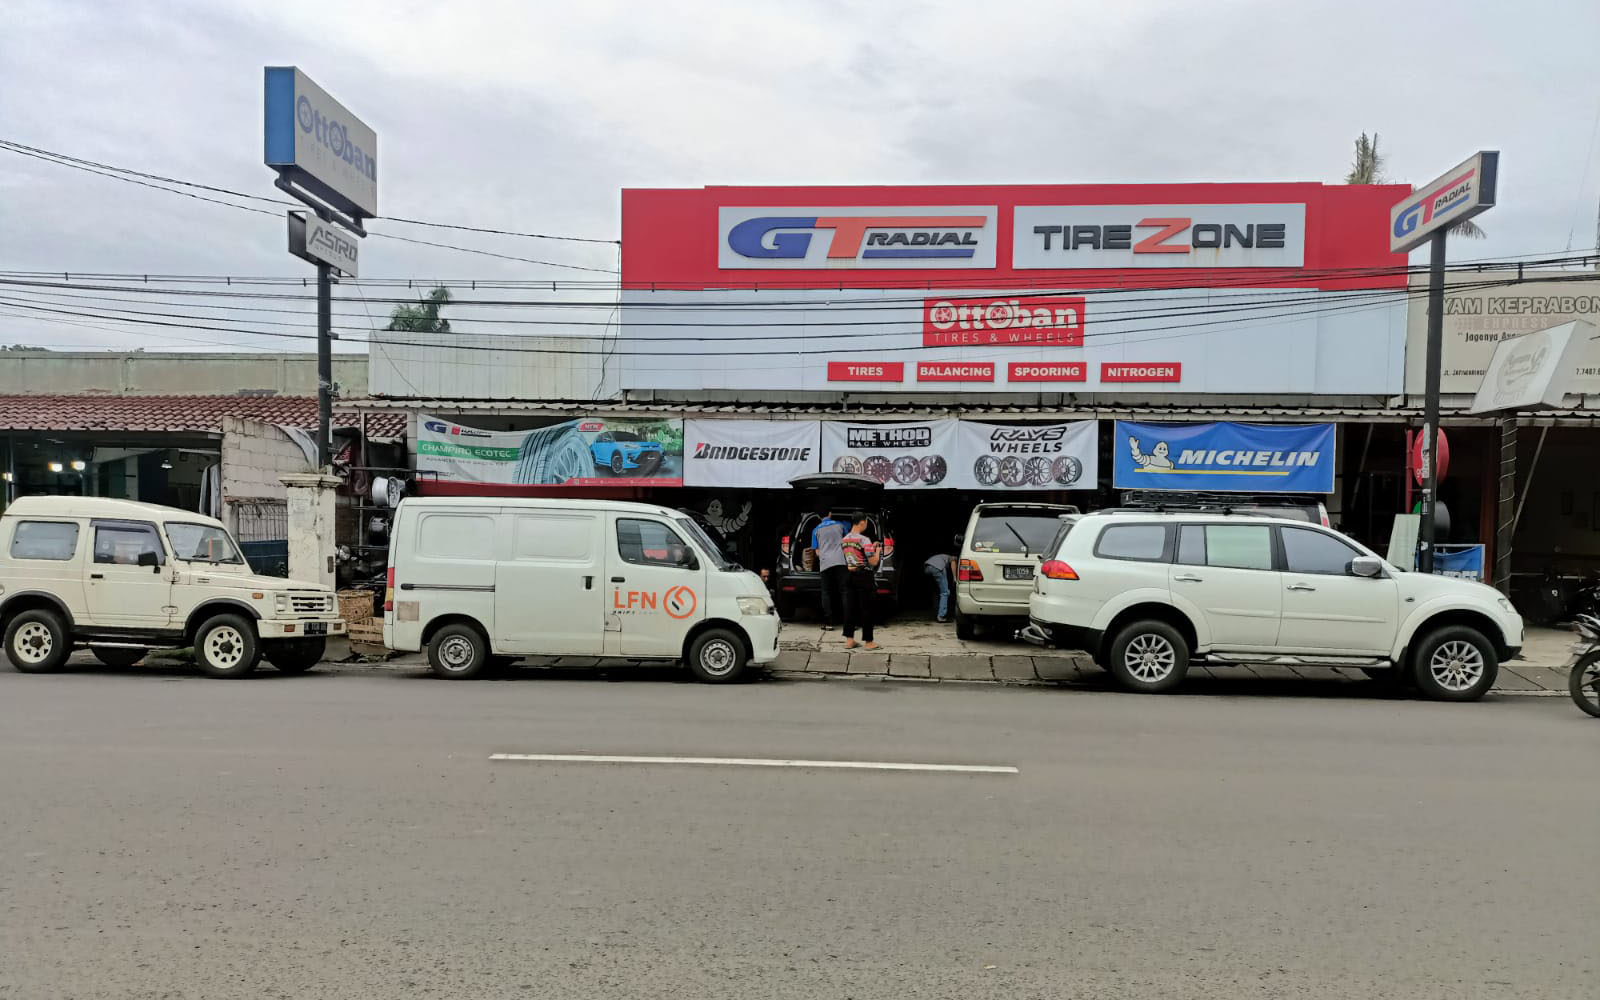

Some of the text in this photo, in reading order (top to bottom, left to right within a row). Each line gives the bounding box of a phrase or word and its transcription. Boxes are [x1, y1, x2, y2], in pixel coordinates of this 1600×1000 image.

[1434, 182, 1471, 210] RADIAL
[309, 226, 358, 262] ASTRO
[728, 215, 987, 258] GT RADIAL
[1427, 297, 1482, 315] YAM
[935, 333, 1074, 343] TIRES & WHEELS
[848, 366, 884, 376] TIRES
[920, 366, 992, 377] BALANCING
[1014, 366, 1080, 377] SPOORING
[1107, 367, 1174, 377] NITROGEN
[849, 429, 929, 441] METHOD
[990, 426, 1067, 441] RAYS
[693, 442, 811, 462] BRIDGESTONE
[990, 442, 1063, 453] WHEELS
[1177, 449, 1321, 467] MICHELIN
[614, 590, 657, 609] LFN
